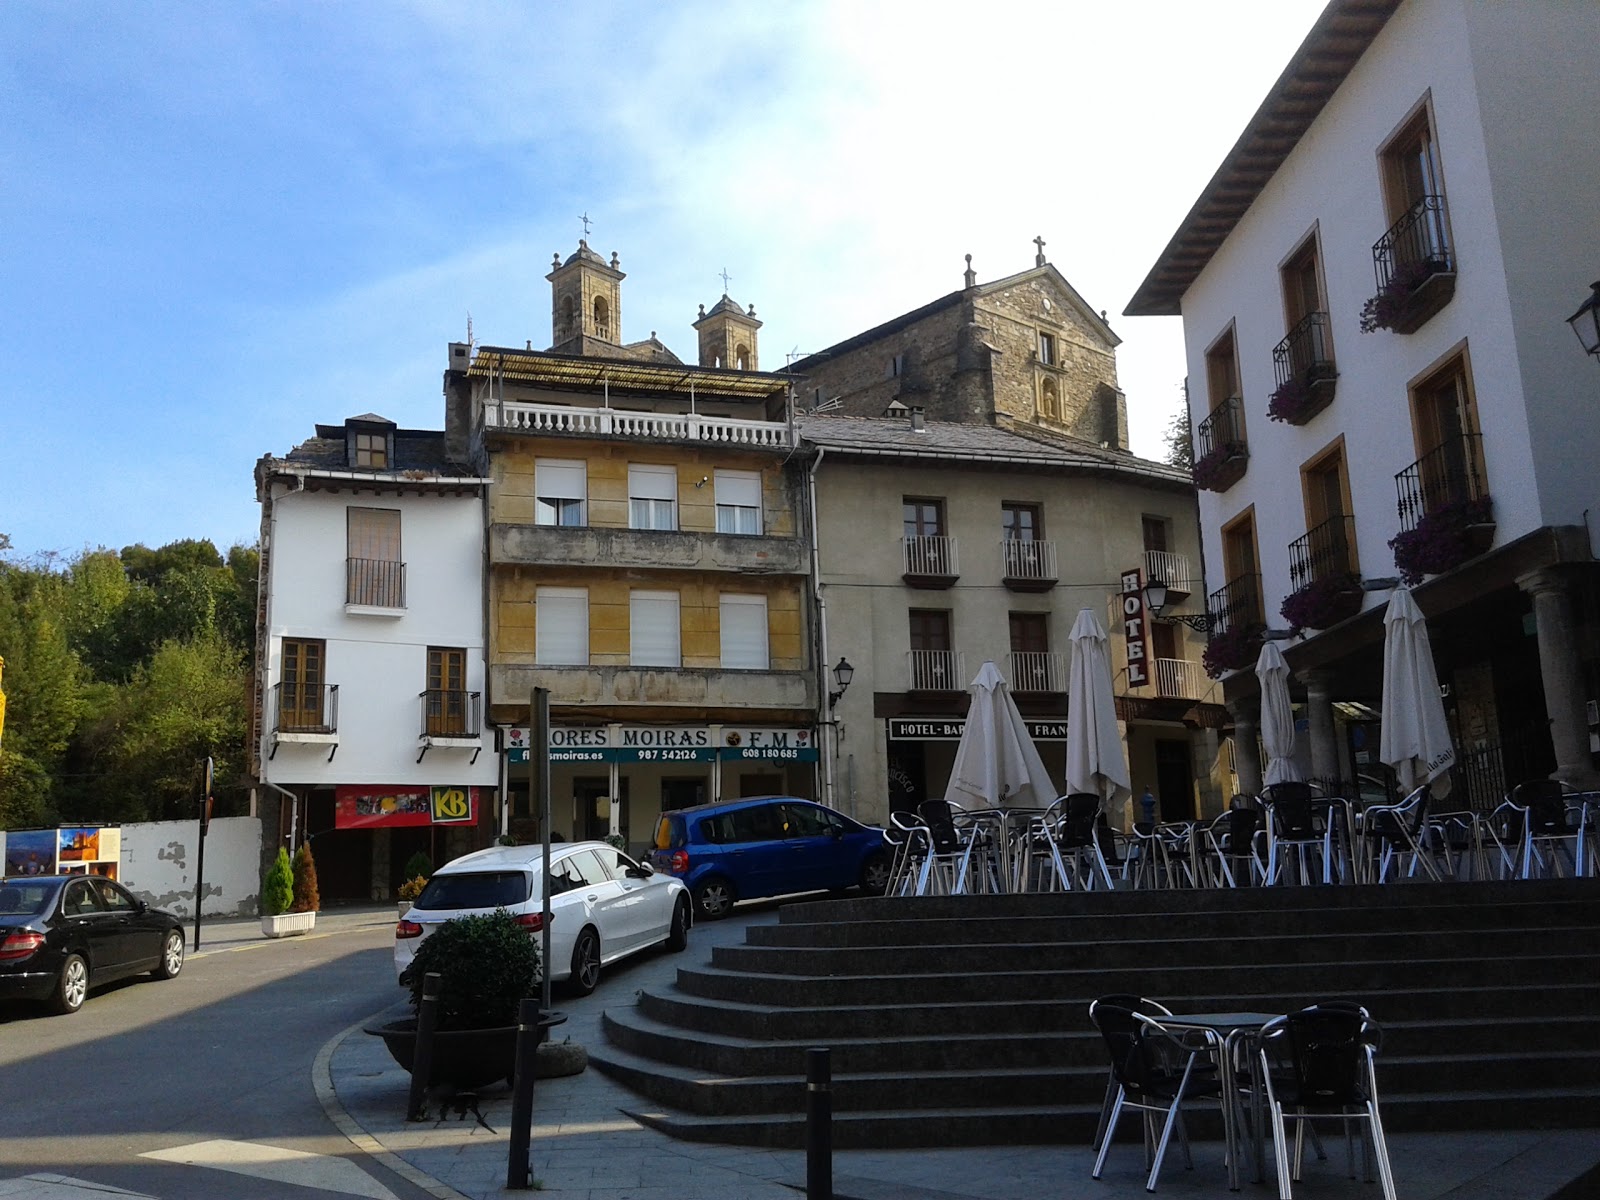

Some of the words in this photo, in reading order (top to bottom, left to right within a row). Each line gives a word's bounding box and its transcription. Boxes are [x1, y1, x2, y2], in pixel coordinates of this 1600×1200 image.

[1122, 573, 1145, 681] HOTEL
[528, 728, 606, 747] ORES
[622, 728, 708, 747] MOIRAS
[1034, 723, 1069, 736] FRAN
[638, 750, 658, 761] 987
[661, 750, 697, 761] 542126
[742, 749, 760, 759] 608
[761, 749, 780, 759] 180
[780, 749, 798, 759] 685
[436, 787, 467, 817] KB
